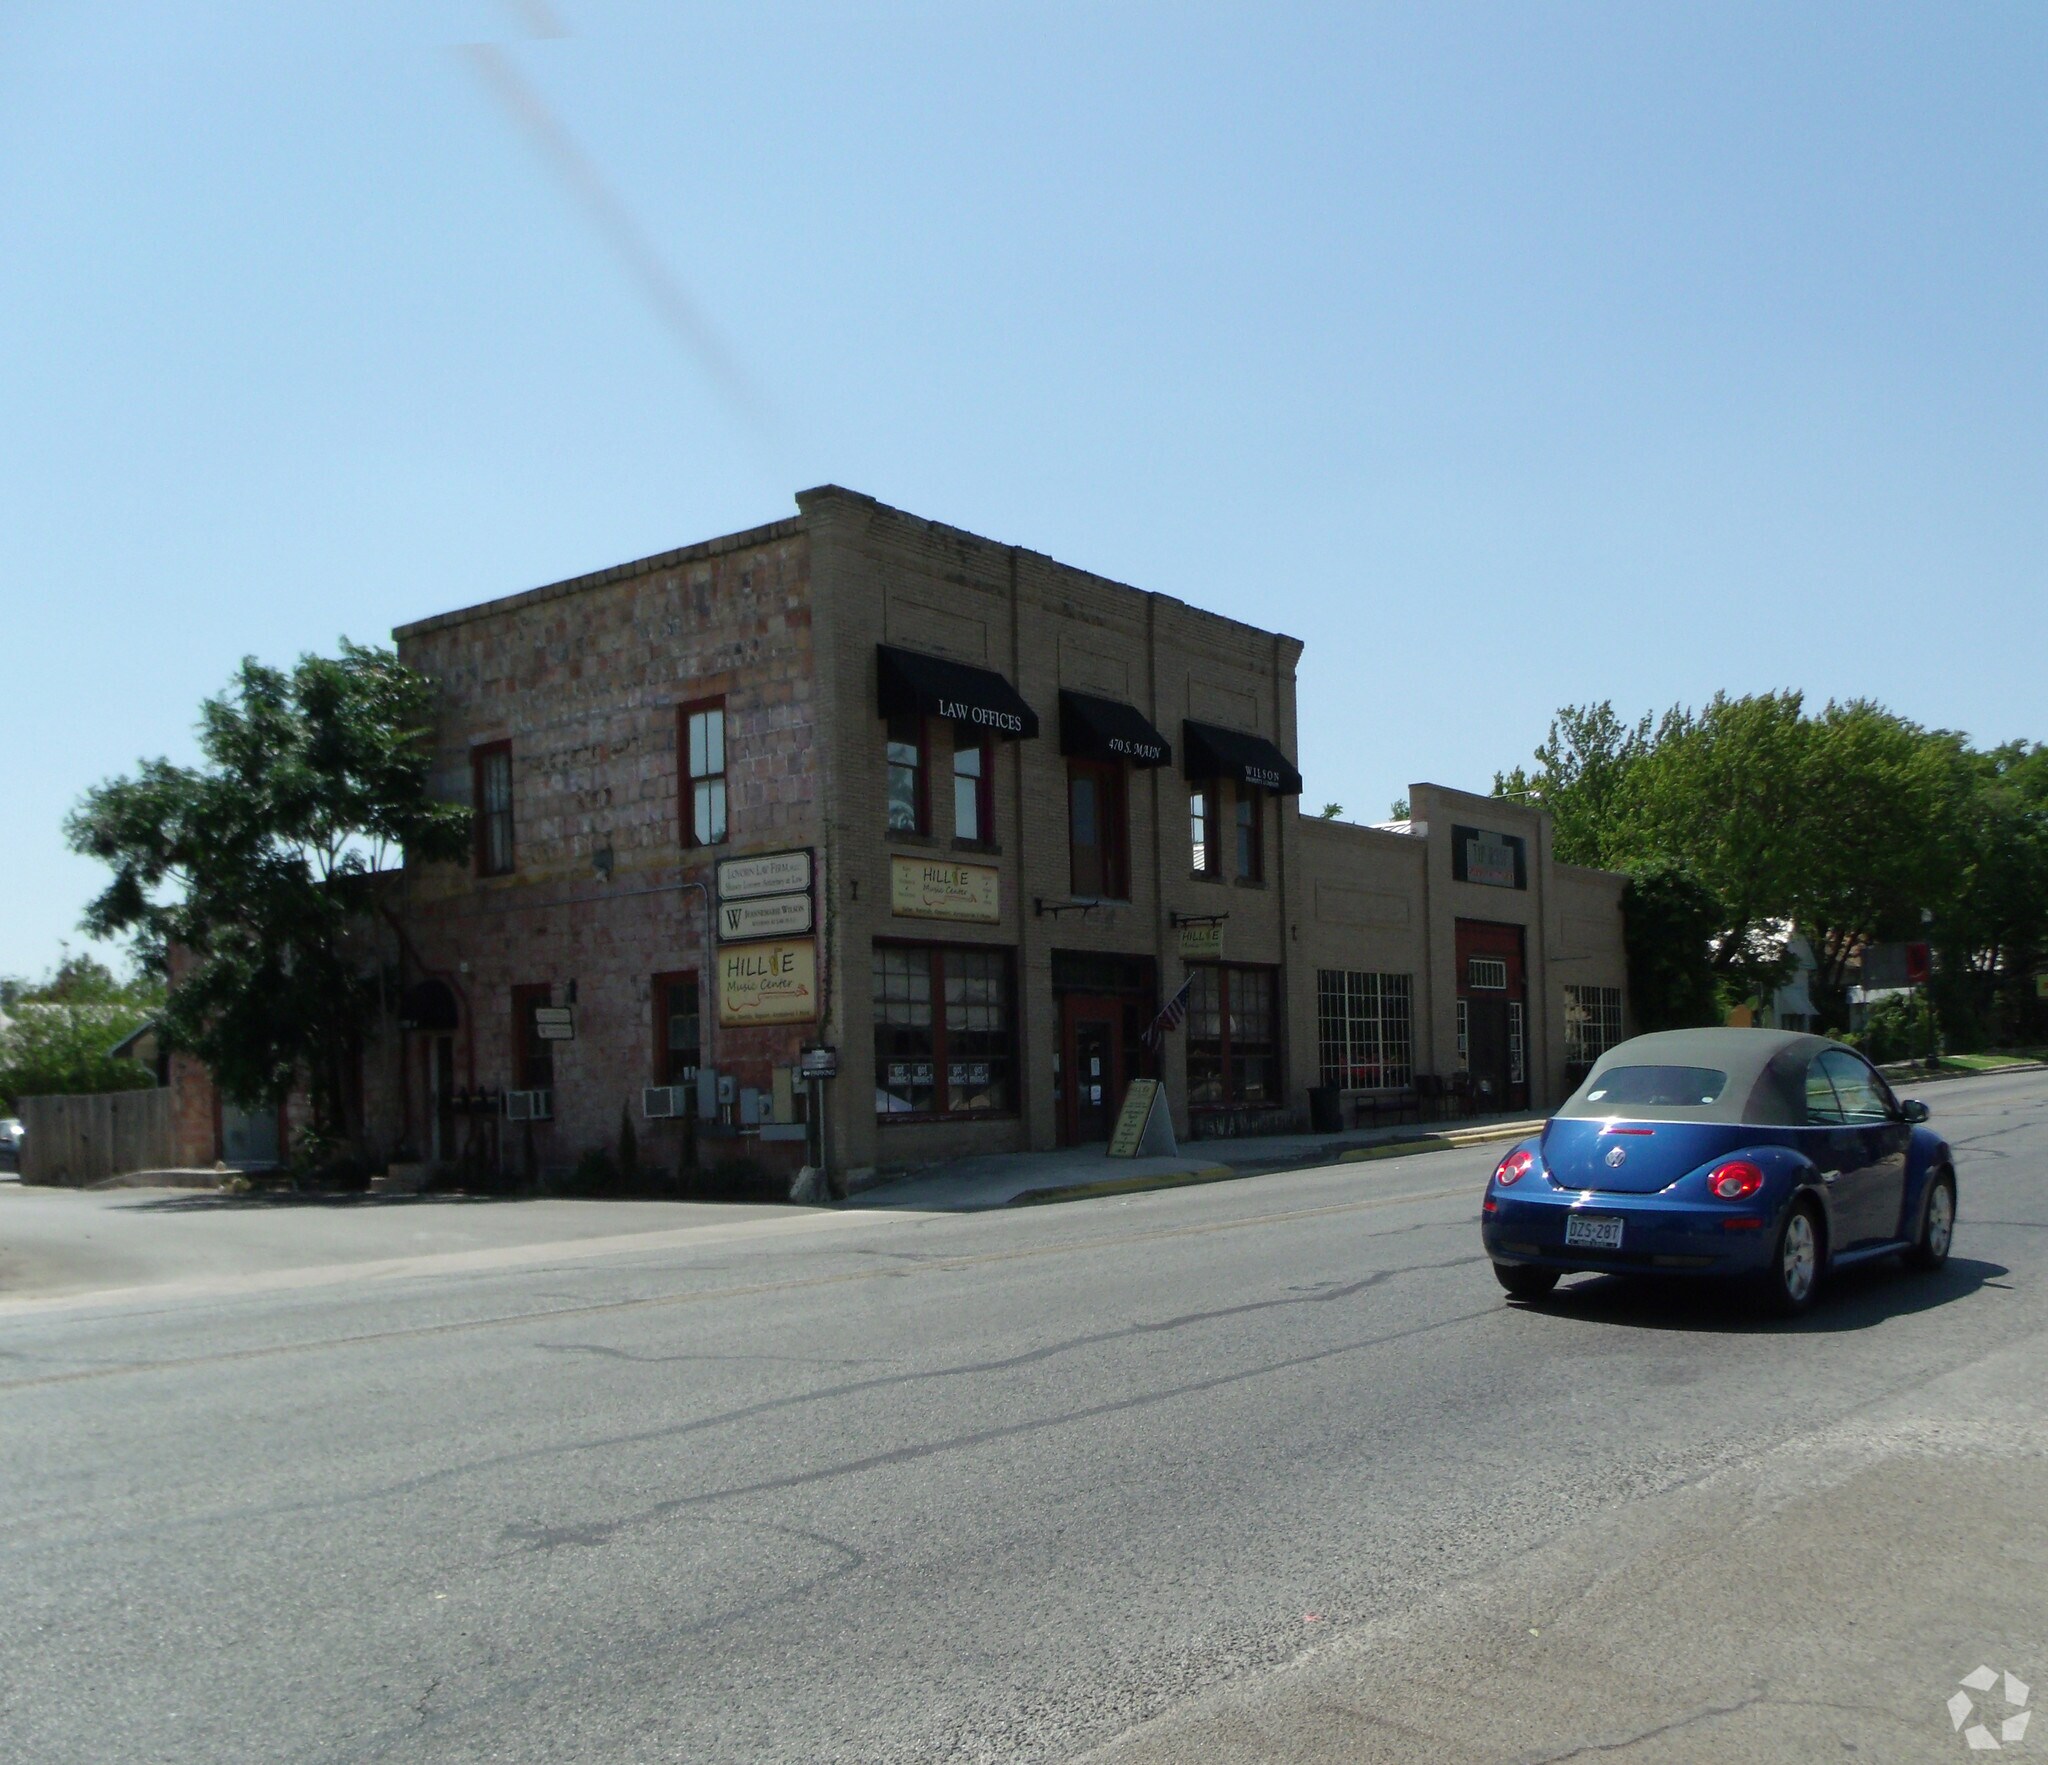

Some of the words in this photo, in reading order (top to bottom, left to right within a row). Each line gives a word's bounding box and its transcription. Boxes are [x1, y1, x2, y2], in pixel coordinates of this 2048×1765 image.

[938, 699, 969, 720] LAW
[971, 707, 1022, 732] OFFICES
[1108, 738, 1124, 752] 470
[1124, 741, 1132, 754] S.
[1133, 742, 1162, 759] MAIN
[1245, 765, 1280, 781] WILSON
[726, 908, 742, 931] W
[727, 980, 757, 993] Music
[760, 978, 793, 991] Center
